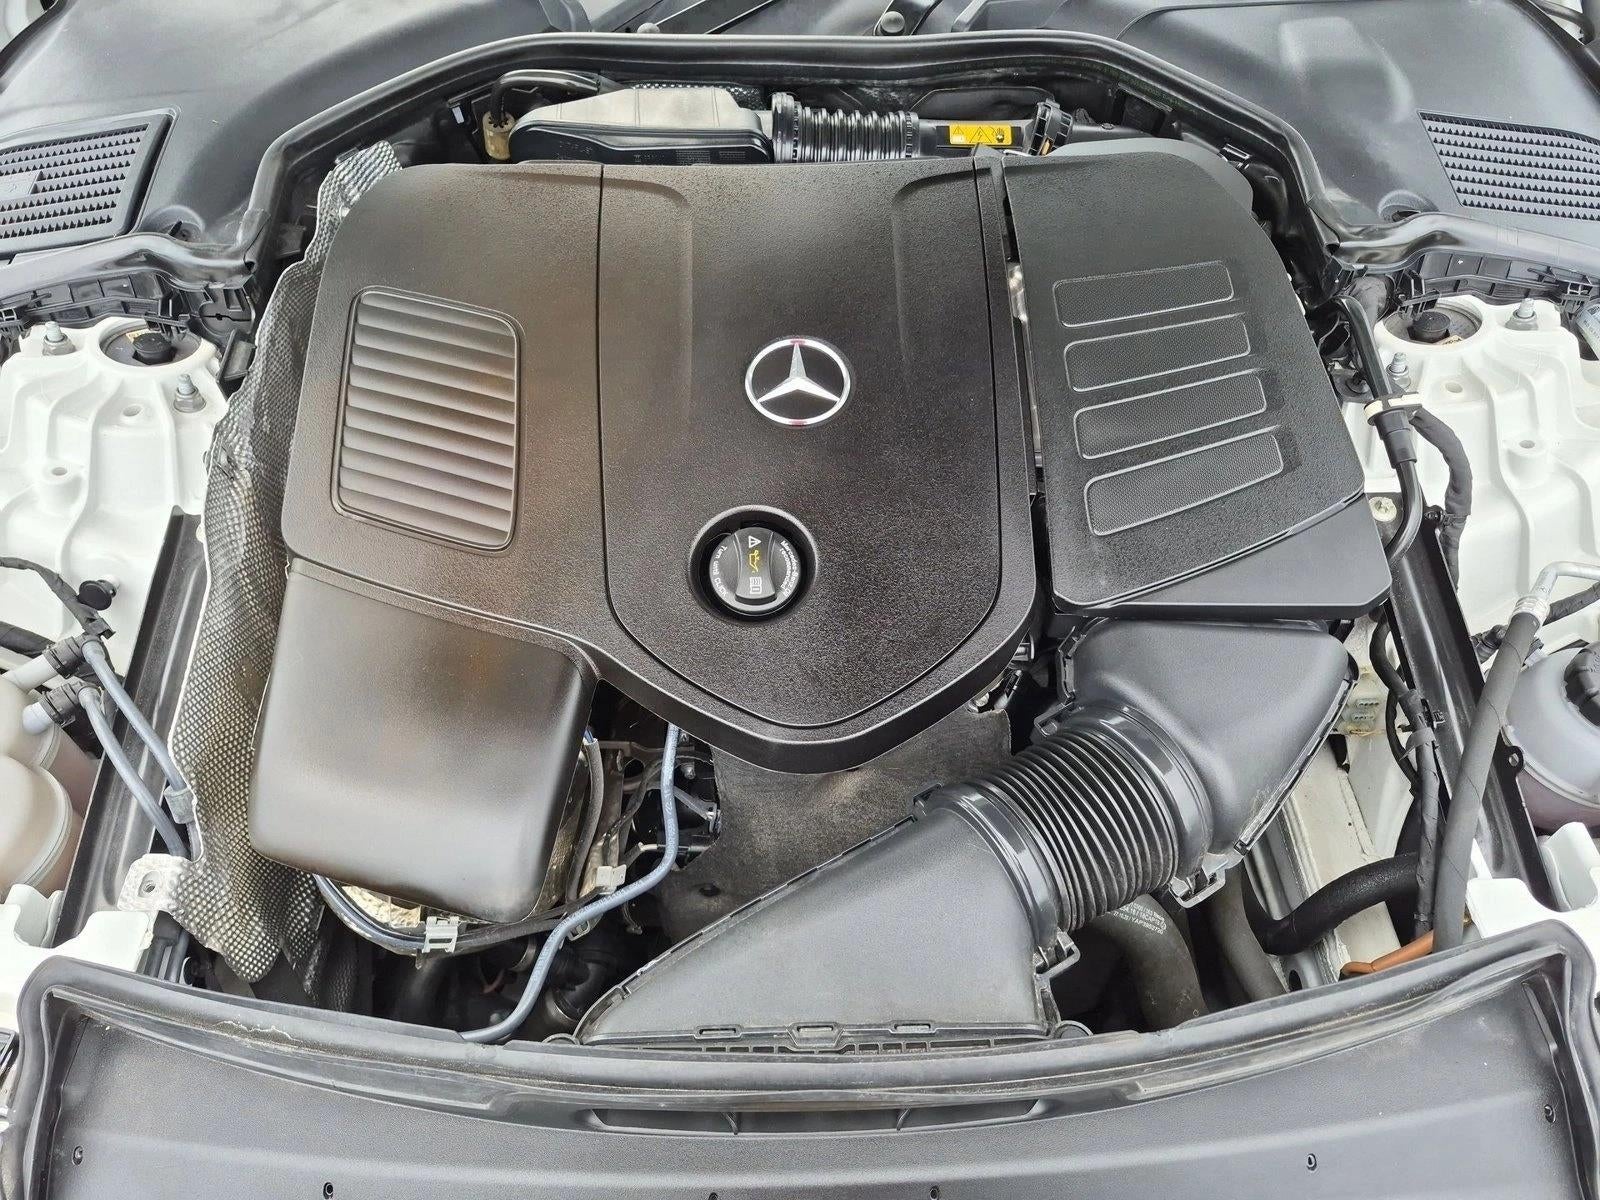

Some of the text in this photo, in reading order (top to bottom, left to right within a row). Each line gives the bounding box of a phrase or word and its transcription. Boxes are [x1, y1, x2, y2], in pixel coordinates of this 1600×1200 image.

[712, 545, 728, 597] Turn until CLICK
